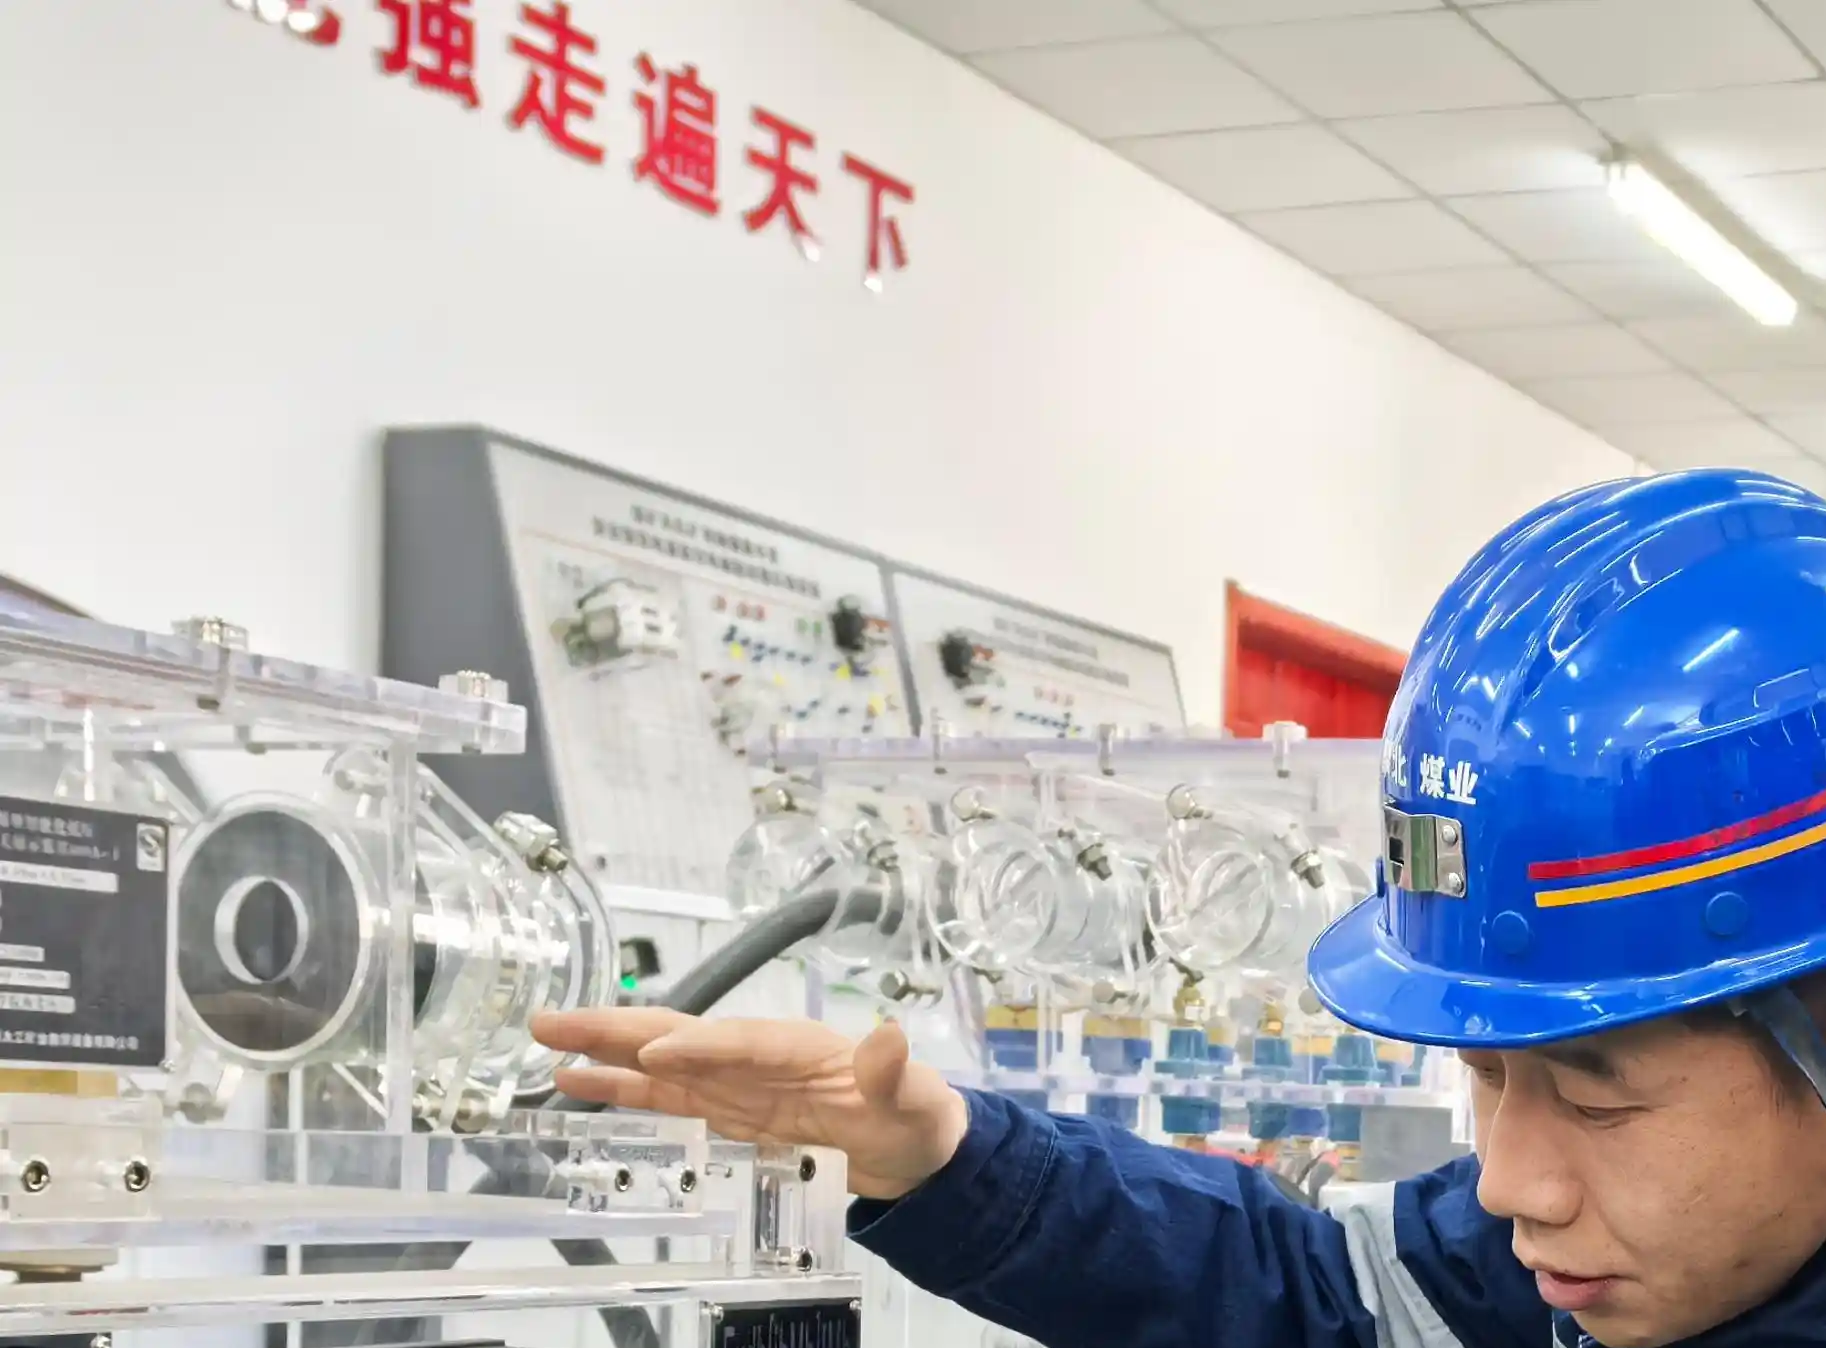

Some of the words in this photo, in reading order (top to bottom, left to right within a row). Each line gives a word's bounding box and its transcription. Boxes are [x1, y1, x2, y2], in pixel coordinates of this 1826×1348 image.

[300, 0, 914, 275] 强走遍天下
